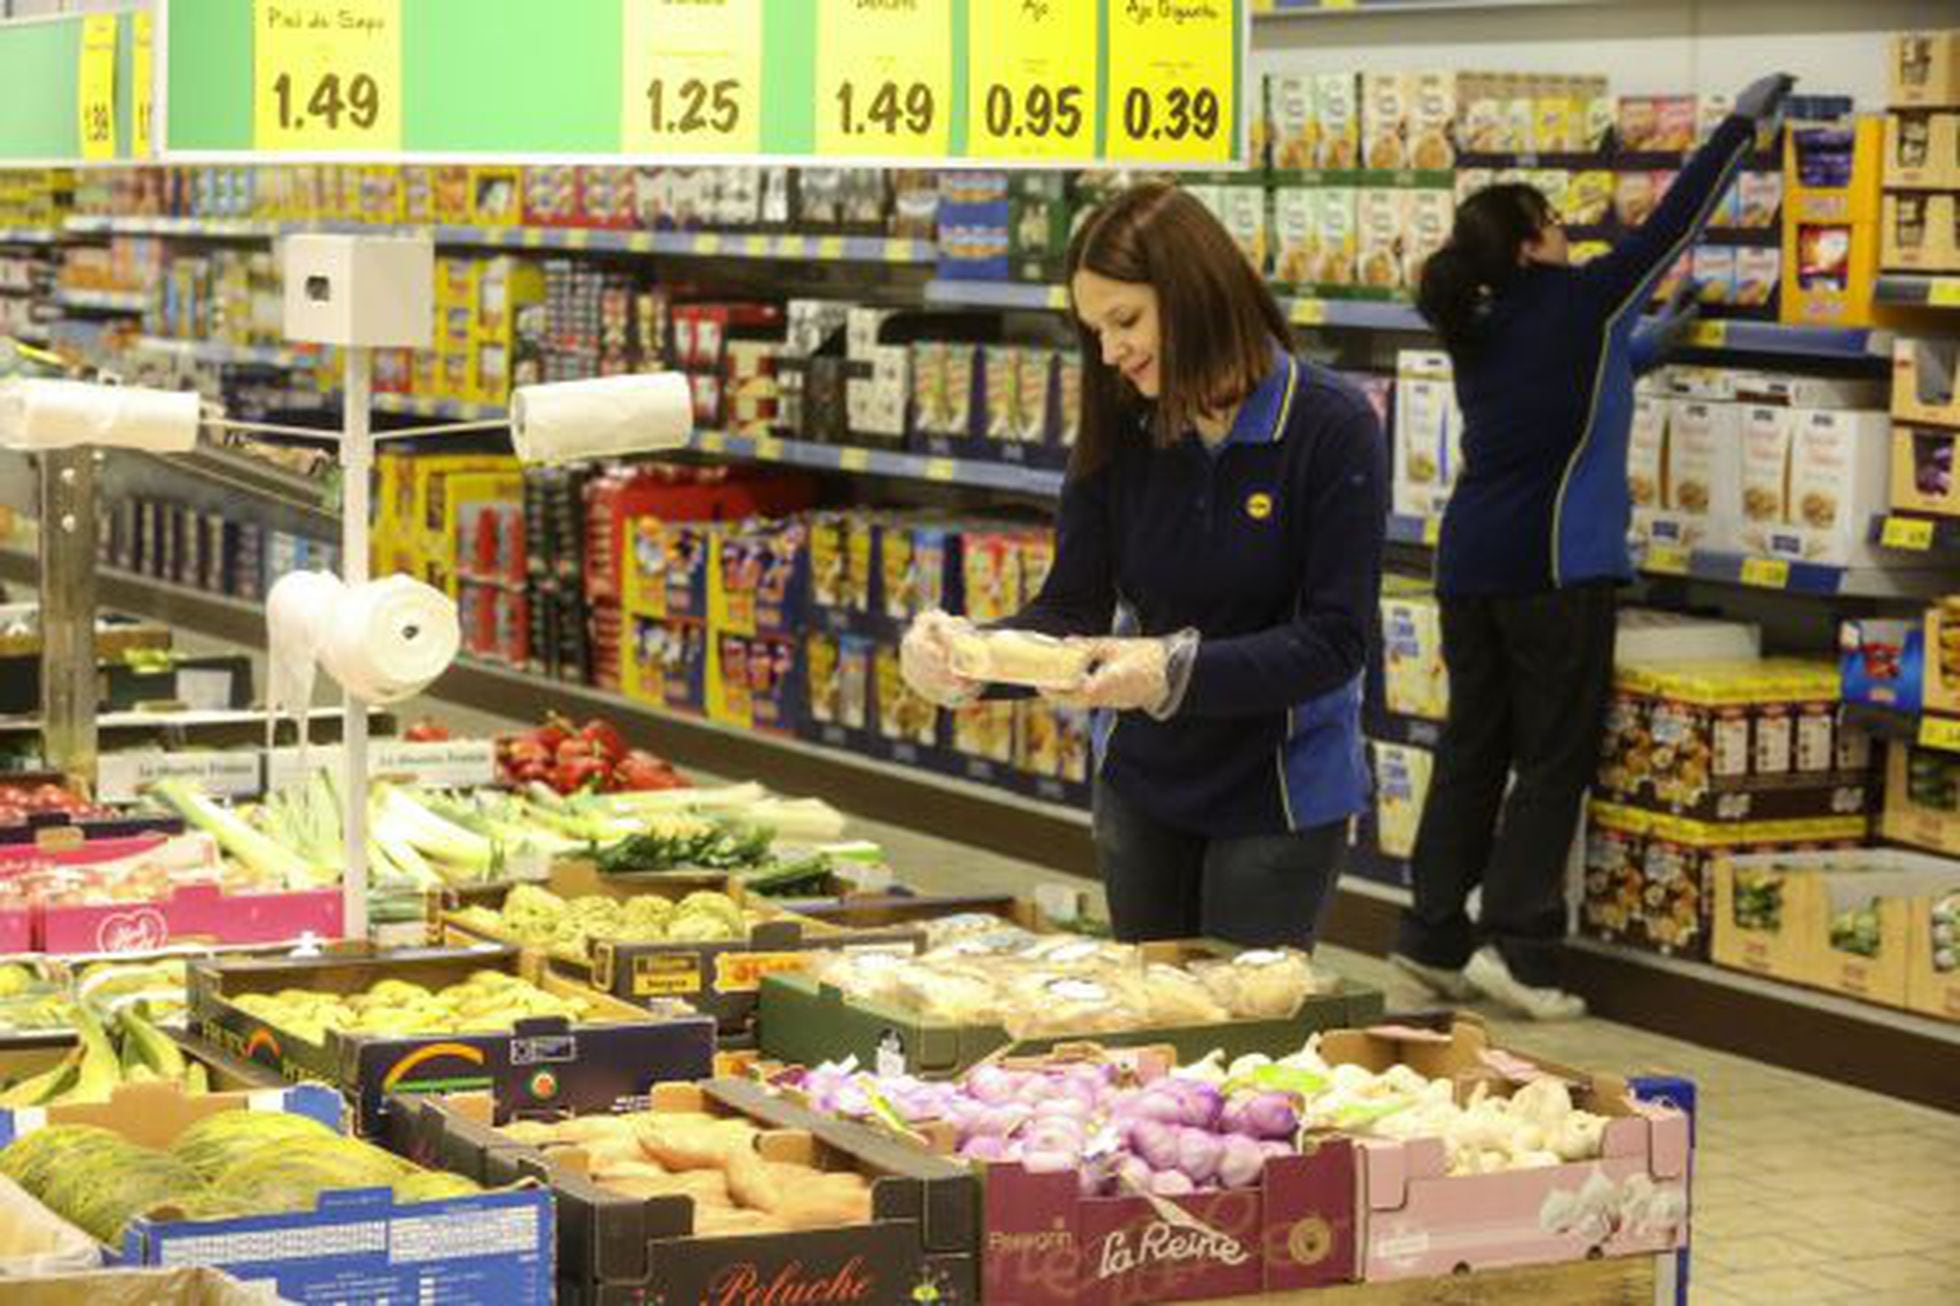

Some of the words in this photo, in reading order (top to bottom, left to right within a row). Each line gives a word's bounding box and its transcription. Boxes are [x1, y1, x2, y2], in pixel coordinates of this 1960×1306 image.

[273, 72, 378, 129] 1.49
[647, 79, 740, 134] 1.25
[836, 80, 934, 135] 1.49
[986, 84, 1082, 137] 0.95
[1125, 87, 1218, 140] 0.39
[1140, 1220, 1249, 1266] Reine
